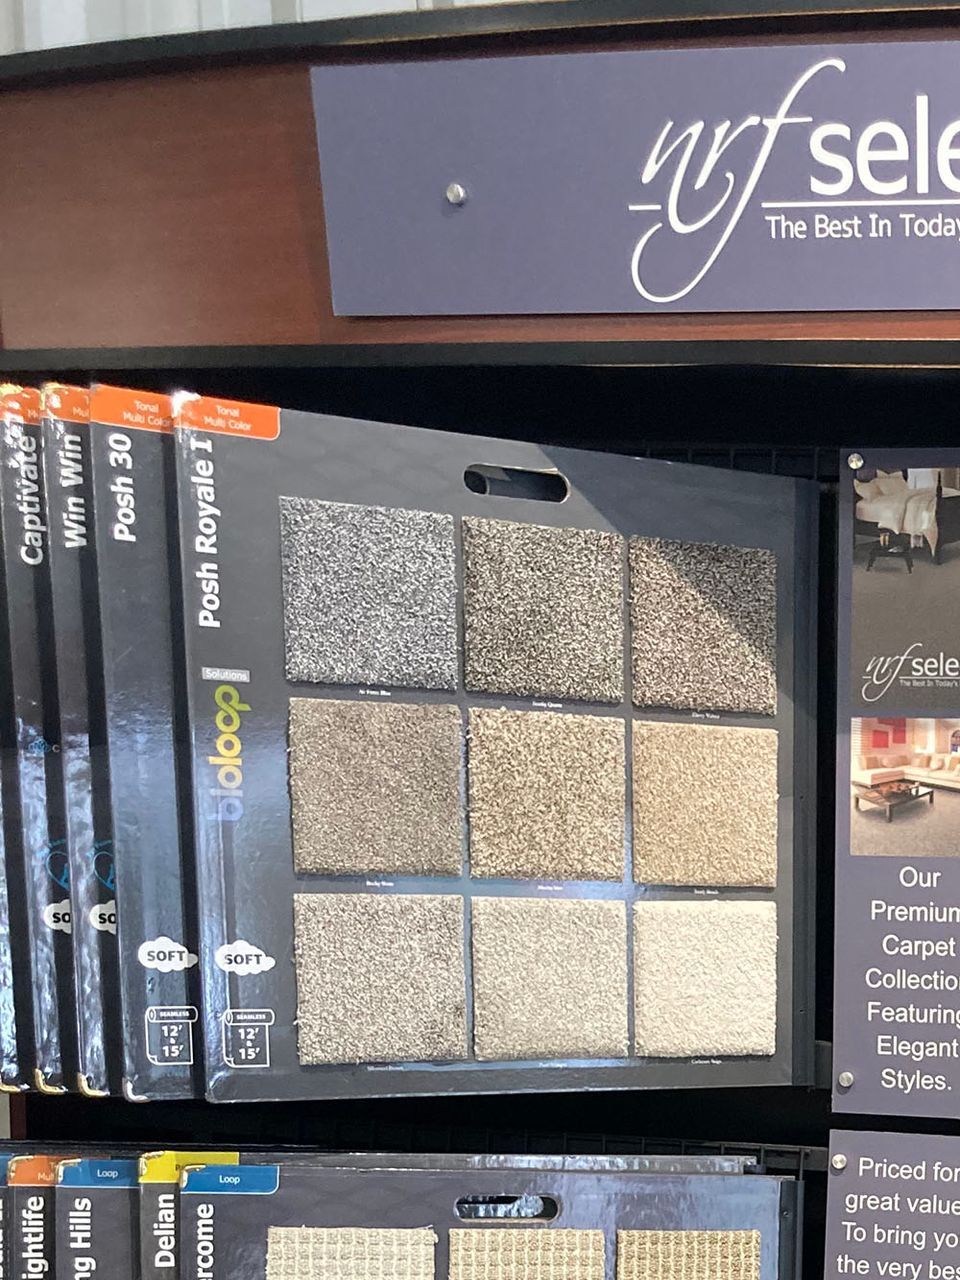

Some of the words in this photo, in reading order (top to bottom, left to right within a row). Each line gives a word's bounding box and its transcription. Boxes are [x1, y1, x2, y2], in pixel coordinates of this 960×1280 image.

[628, 58, 846, 303] nrf
[764, 214, 807, 239] The
[814, 213, 862, 238] Best
[869, 213, 892, 238] In
[123, 411, 145, 423] Multi
[134, 400, 160, 413] Tonal
[216, 405, 240, 418] Tonal
[203, 415, 226, 428] Multi
[228, 418, 252, 431] Color
[109, 433, 133, 468] 30
[190, 437, 213, 453] I
[60, 434, 83, 488] Win
[18, 435, 47, 566] Captivate
[111, 477, 136, 542] Posh
[191, 465, 221, 554] Royale
[64, 496, 87, 549] Win
[196, 562, 221, 628] Posh
[205, 668, 248, 682] Solutions
[861, 642, 923, 702] nrf
[899, 867, 941, 888] Our
[147, 950, 186, 962] SOFT
[881, 934, 956, 960] Carpet
[224, 953, 263, 965] SOFT
[161, 1024, 183, 1037] 12'
[238, 1027, 259, 1040] 12'
[162, 1044, 184, 1057] 15'
[238, 1048, 260, 1060] 15'
[876, 1036, 959, 1063] Elegant
[880, 1068, 952, 1094] Styles.
[97, 1169, 118, 1179] Loop
[219, 1174, 241, 1185] Loop
[858, 1157, 926, 1180] Priced
[845, 1193, 900, 1213] great
[69, 1198, 92, 1248] Hills
[153, 1193, 175, 1268] Delian
[841, 1221, 867, 1242] To
[874, 1223, 926, 1250] bring
[836, 1254, 870, 1275] the
